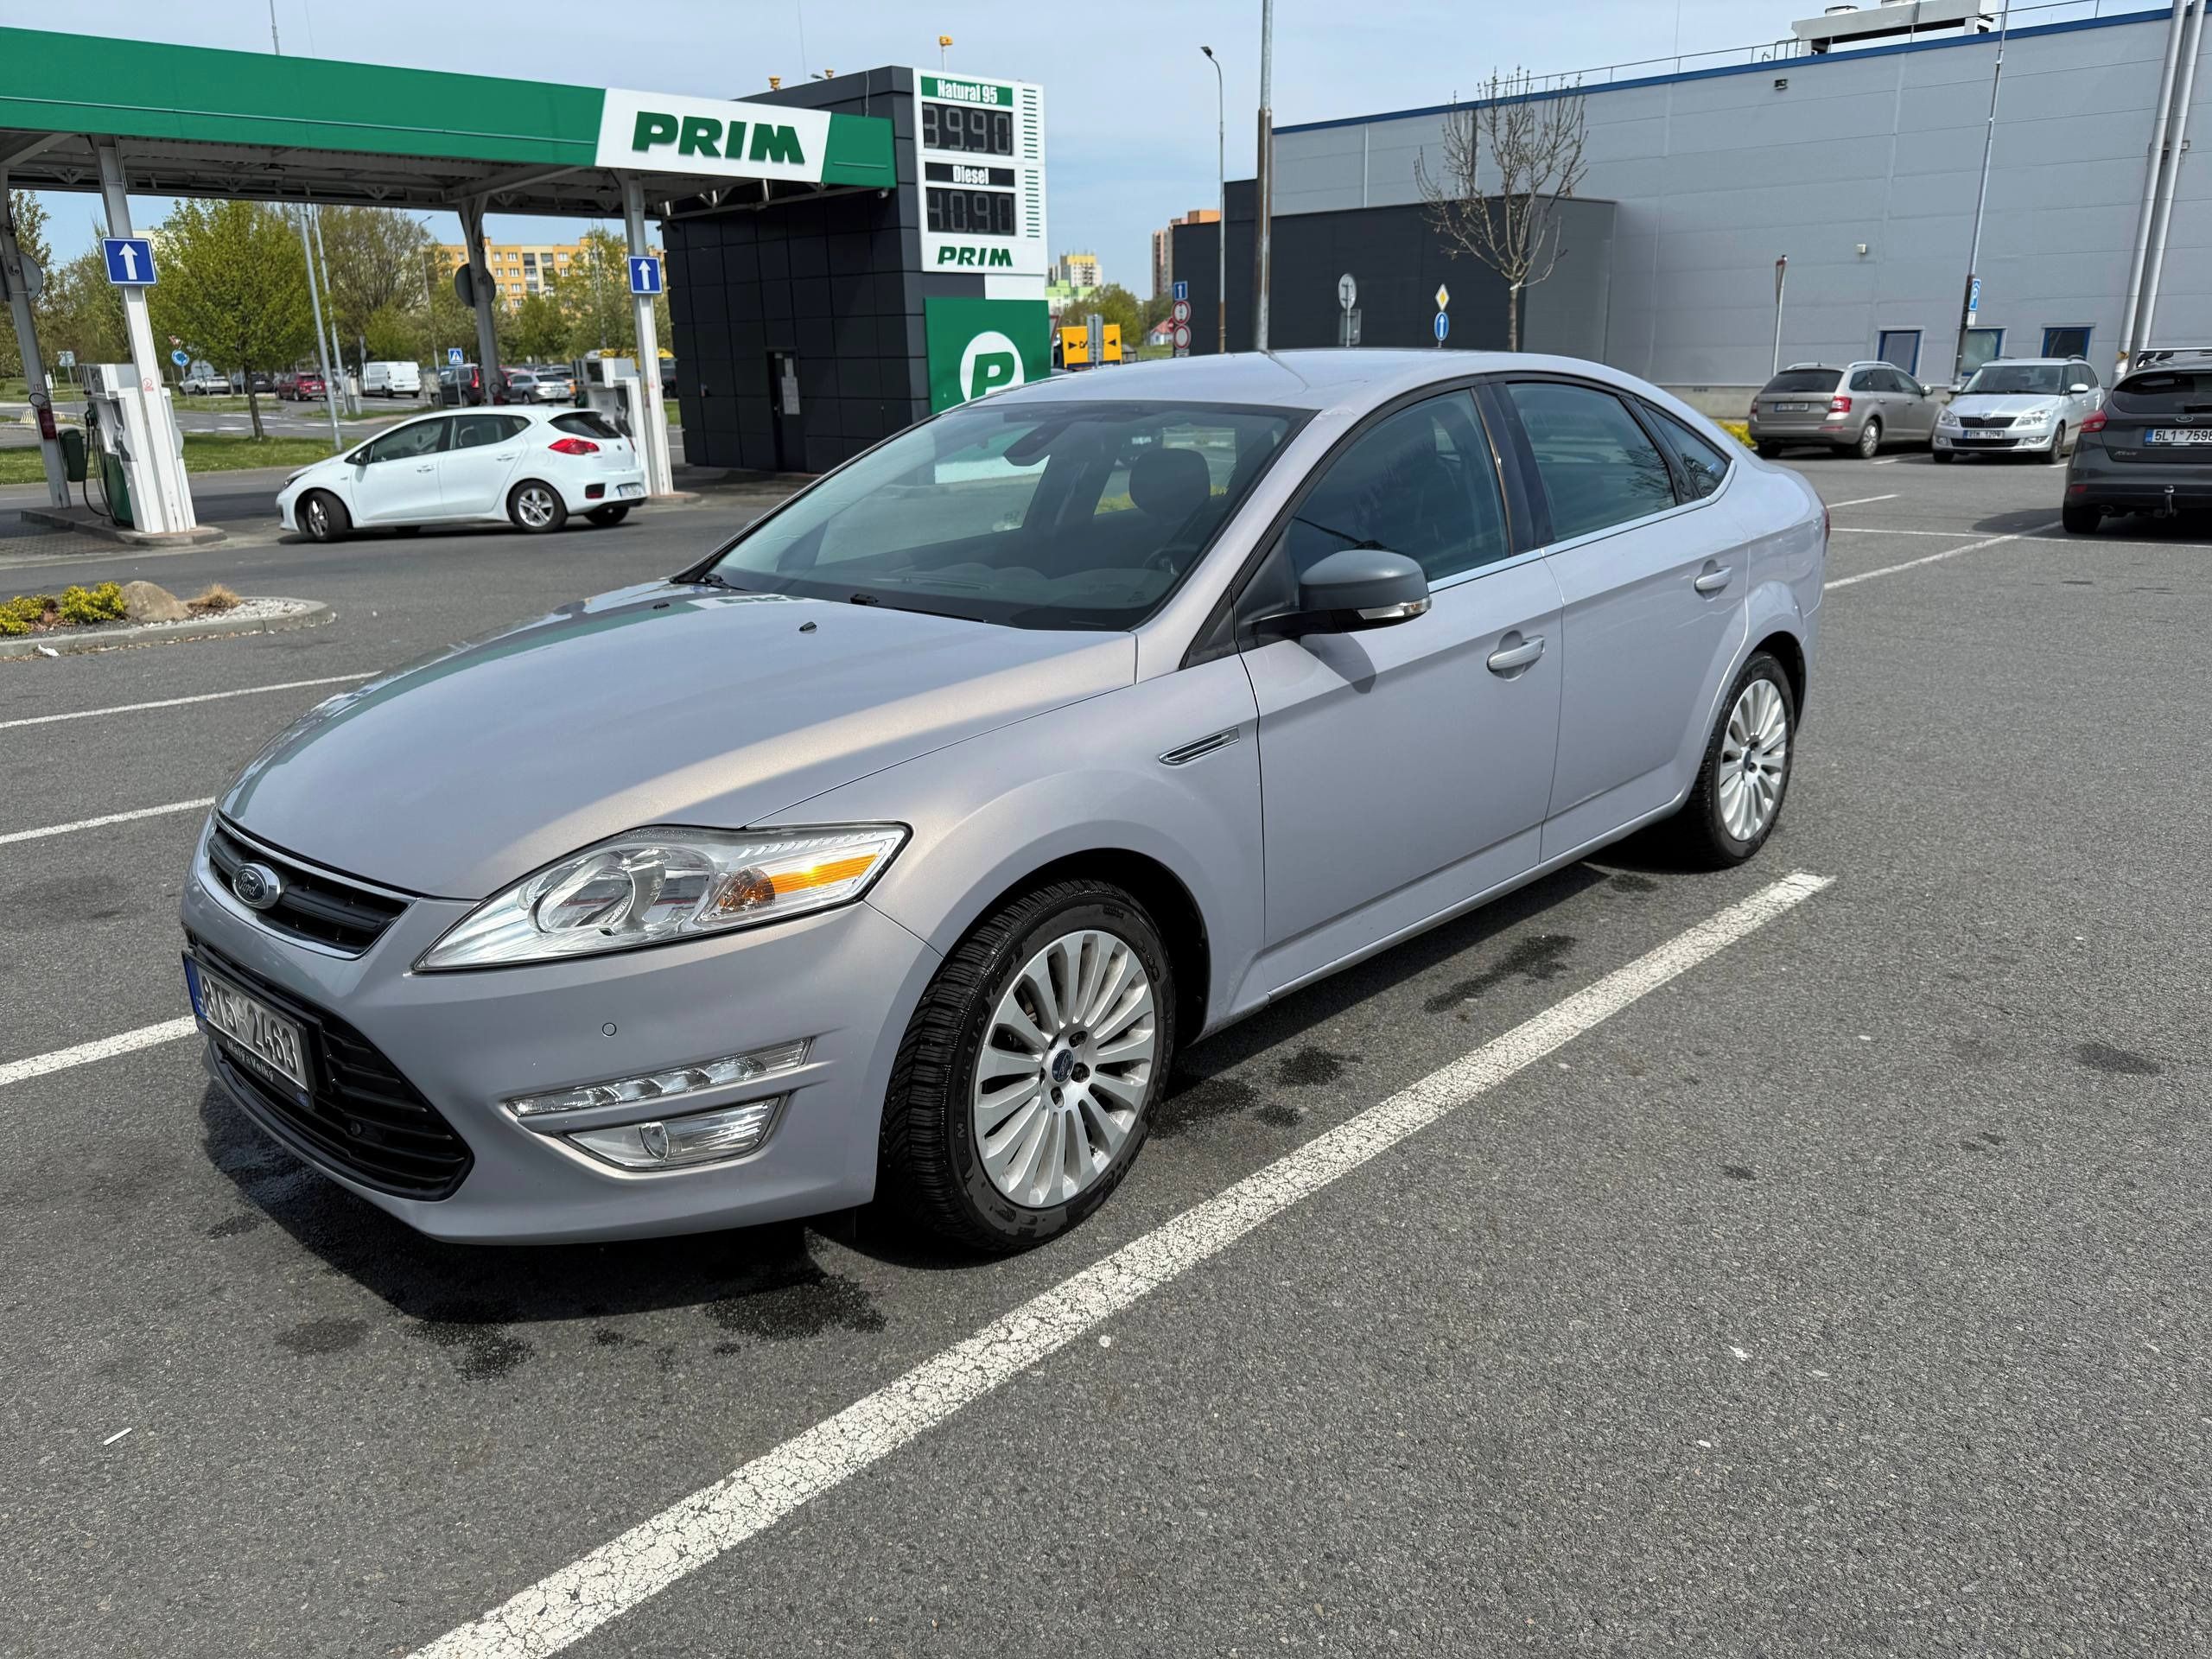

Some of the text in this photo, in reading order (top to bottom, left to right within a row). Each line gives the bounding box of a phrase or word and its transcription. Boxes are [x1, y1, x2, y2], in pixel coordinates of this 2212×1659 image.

[937, 79, 998, 104] Natural 95
[632, 111, 805, 165] PRIM
[952, 165, 989, 185] Diesel
[938, 246, 1013, 267] PRIM
[970, 352, 1015, 400] P
[2155, 430, 2177, 441] 5L1
[238, 872, 259, 896] Ford
[246, 1002, 299, 1075] 2463
